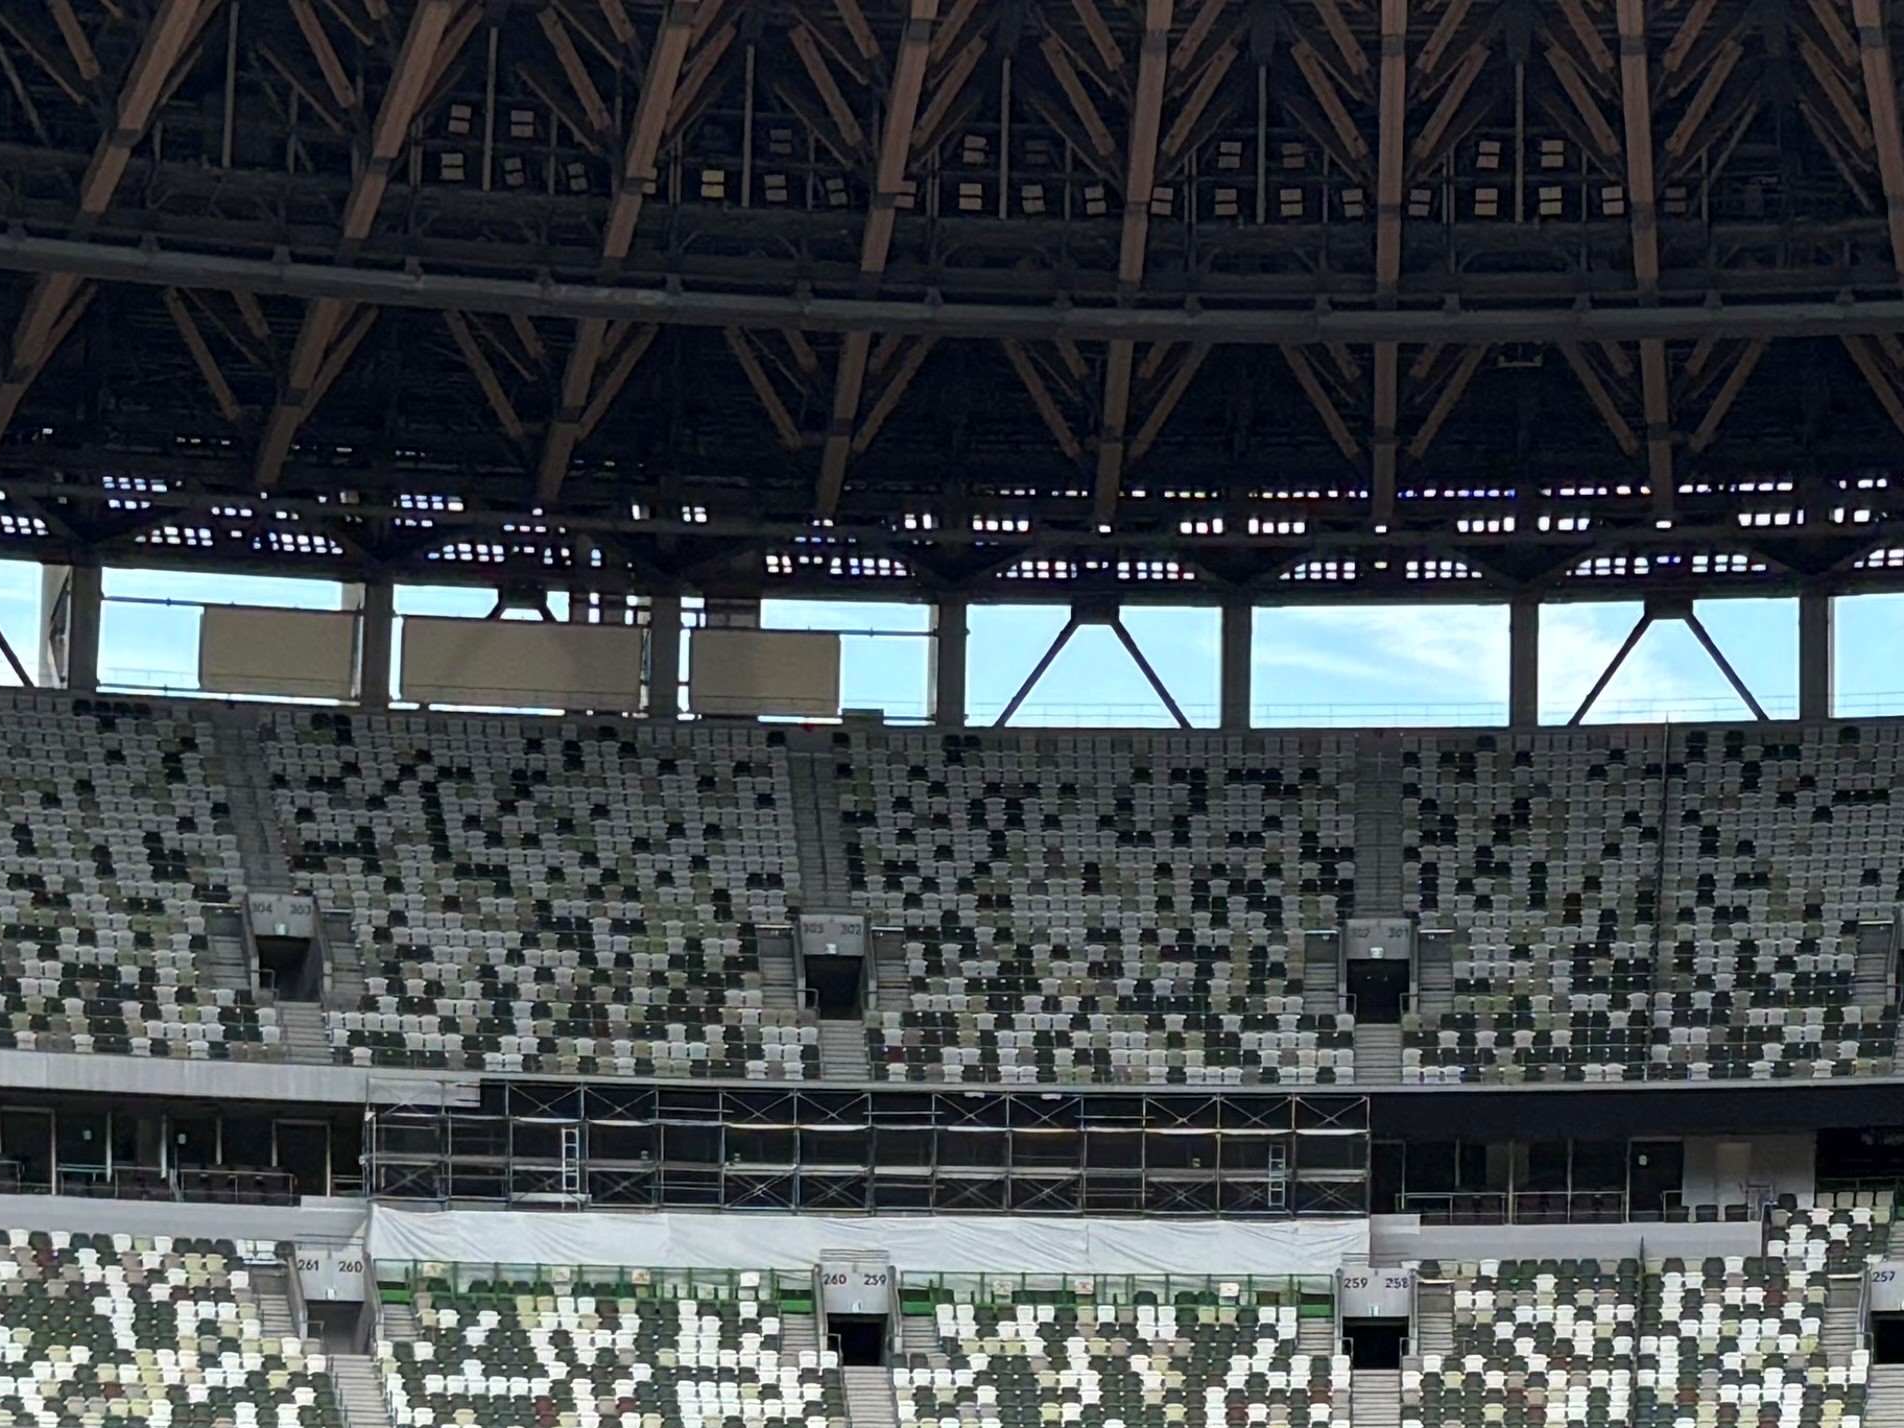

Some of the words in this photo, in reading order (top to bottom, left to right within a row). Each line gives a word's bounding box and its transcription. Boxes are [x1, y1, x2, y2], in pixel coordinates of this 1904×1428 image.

[298, 1260, 319, 1271] 261
[339, 1261, 363, 1273] 260
[824, 1274, 847, 1285] 260
[864, 1274, 887, 1286] 259
[1872, 1271, 1896, 1283] 257
[1344, 1278, 1368, 1289] 259
[1385, 1278, 1410, 1289] 258
